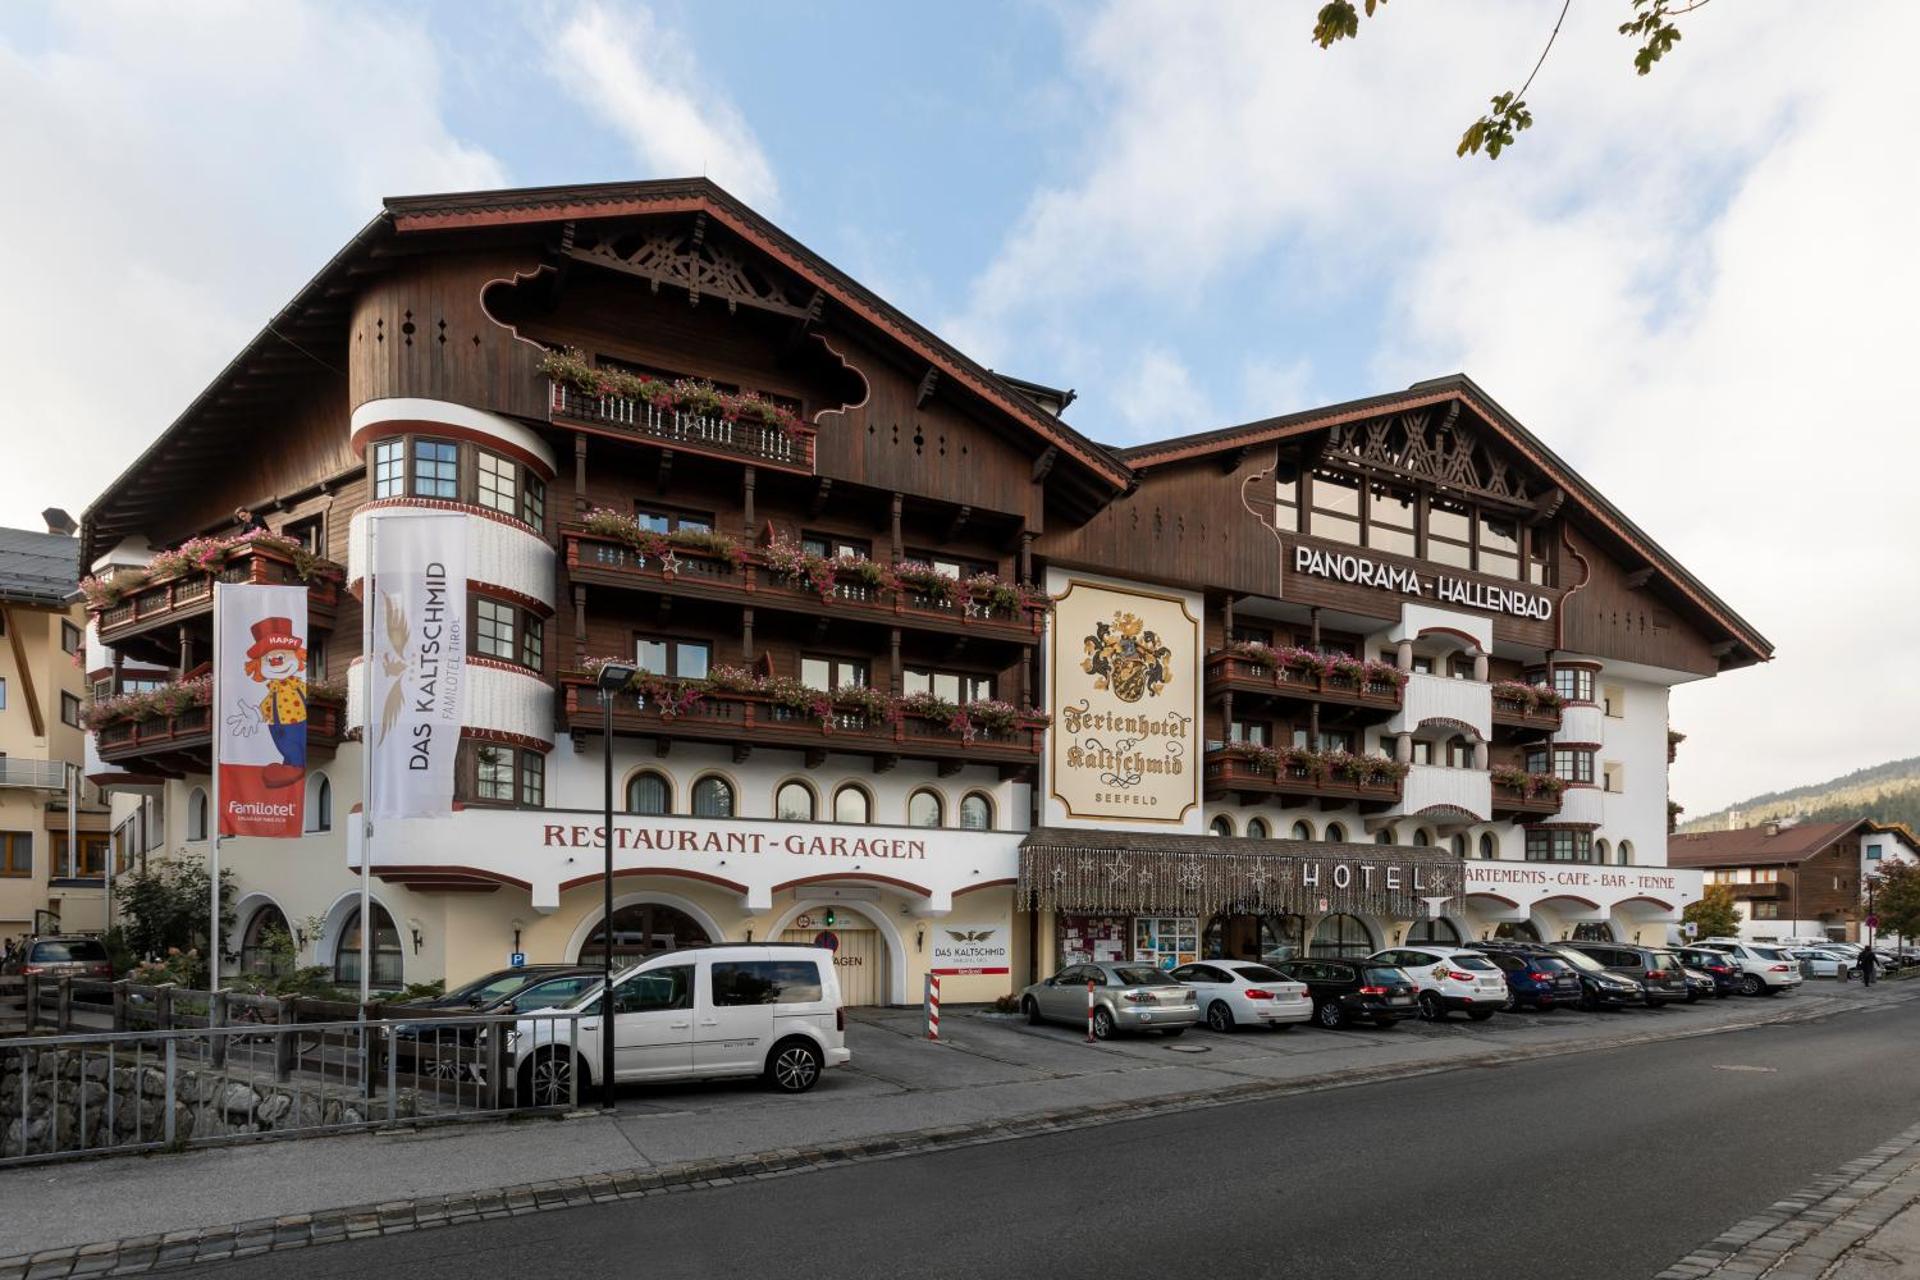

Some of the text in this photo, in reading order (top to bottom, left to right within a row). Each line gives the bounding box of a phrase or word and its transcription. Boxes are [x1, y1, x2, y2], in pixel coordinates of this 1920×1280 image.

[1295, 545, 1422, 597] PANORAMA
[1438, 575, 1552, 621] HALLENBAD
[269, 636, 298, 646] HAPPY
[408, 561, 447, 771] DAS KALTSCHMID
[442, 616, 461, 720] FAMILOTEL TIROL
[1063, 699, 1191, 741] Ferienhotel
[1095, 793, 1158, 806] SEEFELD
[1303, 863, 1426, 890] HOTEL
[1465, 868, 1547, 884] ARTEMENTS
[1557, 871, 1590, 886] CAFE
[1601, 873, 1627, 888] BAR
[1638, 875, 1676, 890] TENNE
[833, 956, 863, 967] AGEN
[935, 946, 1006, 957] DAS KALTSCHMID
